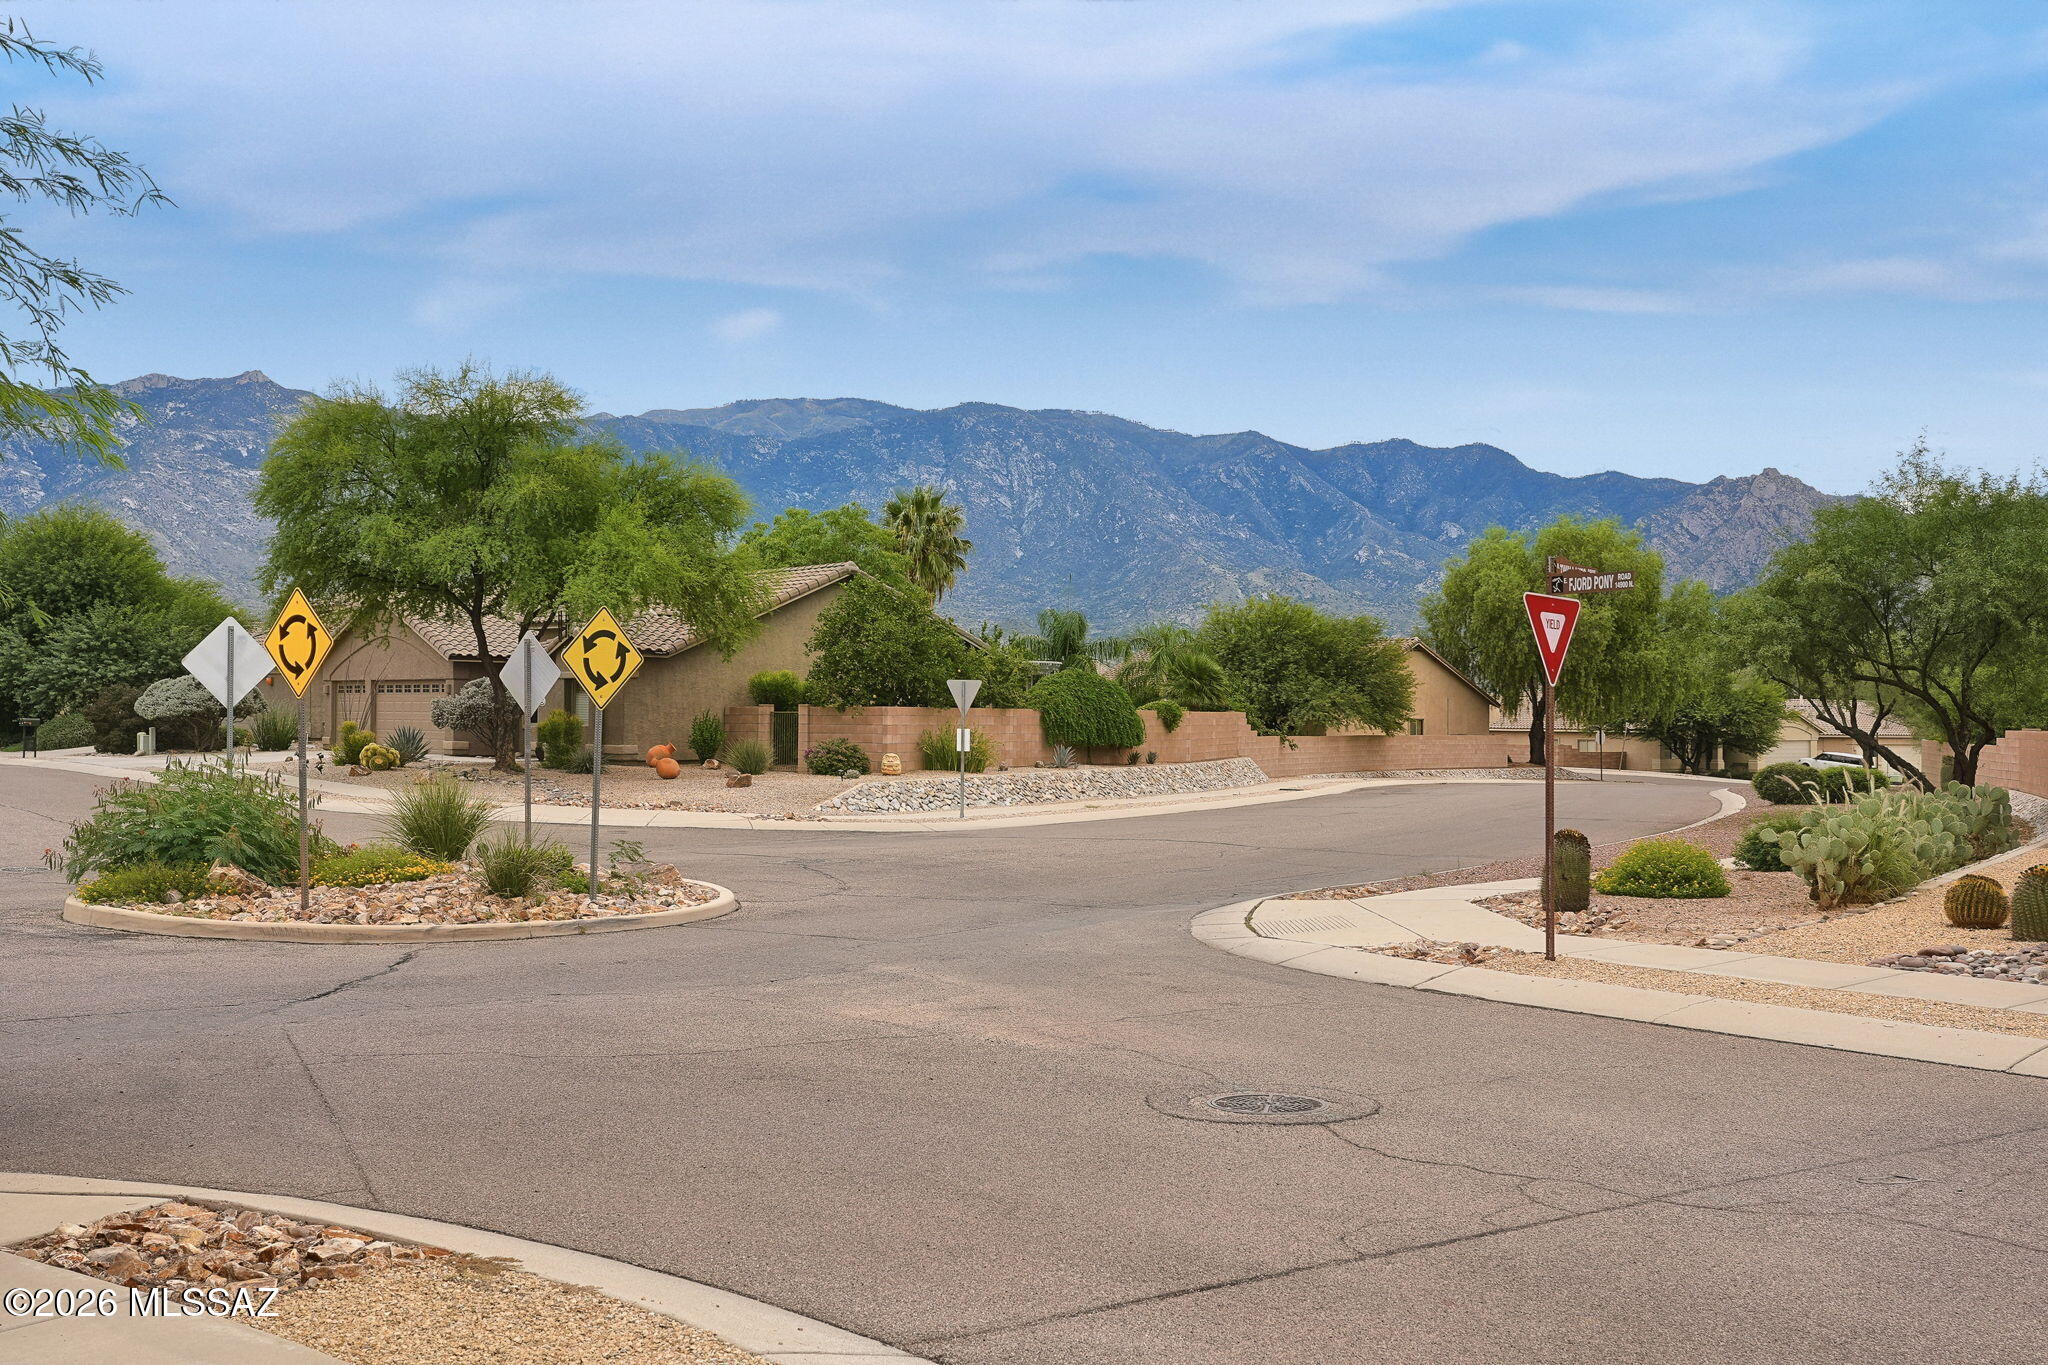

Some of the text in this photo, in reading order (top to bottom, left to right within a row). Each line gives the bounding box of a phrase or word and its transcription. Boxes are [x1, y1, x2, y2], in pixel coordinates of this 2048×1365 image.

[1617, 572, 1632, 580] ROAD
[1568, 576, 1592, 592] FJORD
[1593, 574, 1614, 590] PONY
[1545, 618, 1560, 630] YIELD
